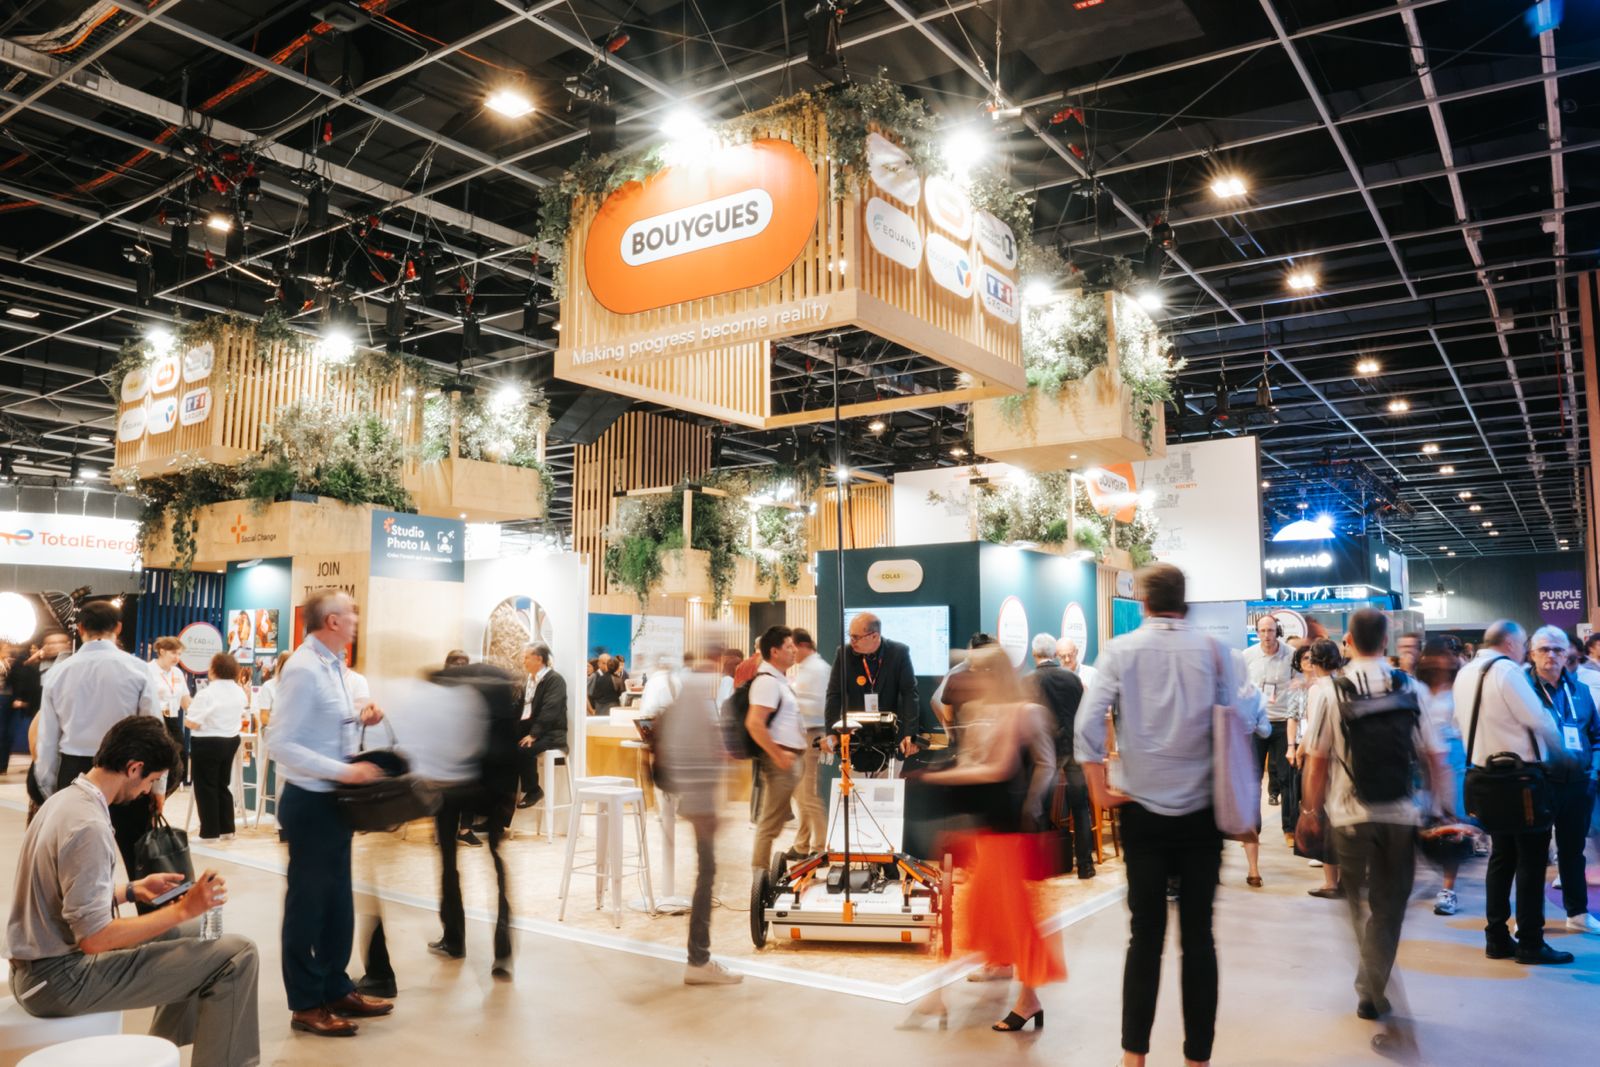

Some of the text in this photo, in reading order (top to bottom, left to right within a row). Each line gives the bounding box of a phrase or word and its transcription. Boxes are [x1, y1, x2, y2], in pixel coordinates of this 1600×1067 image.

[631, 200, 759, 256] BOUYGUES
[882, 224, 916, 250] EQUANS
[986, 272, 1013, 307] TF1
[572, 302, 830, 366] Making progress become reality
[185, 393, 206, 413] TF1
[241, 532, 277, 543] Social Change
[391, 524, 425, 539] Studio
[387, 537, 431, 552] Photo IA
[317, 561, 340, 577] JOIN
[1539, 590, 1582, 600] PURPLE
[1542, 600, 1580, 610] STAGE
